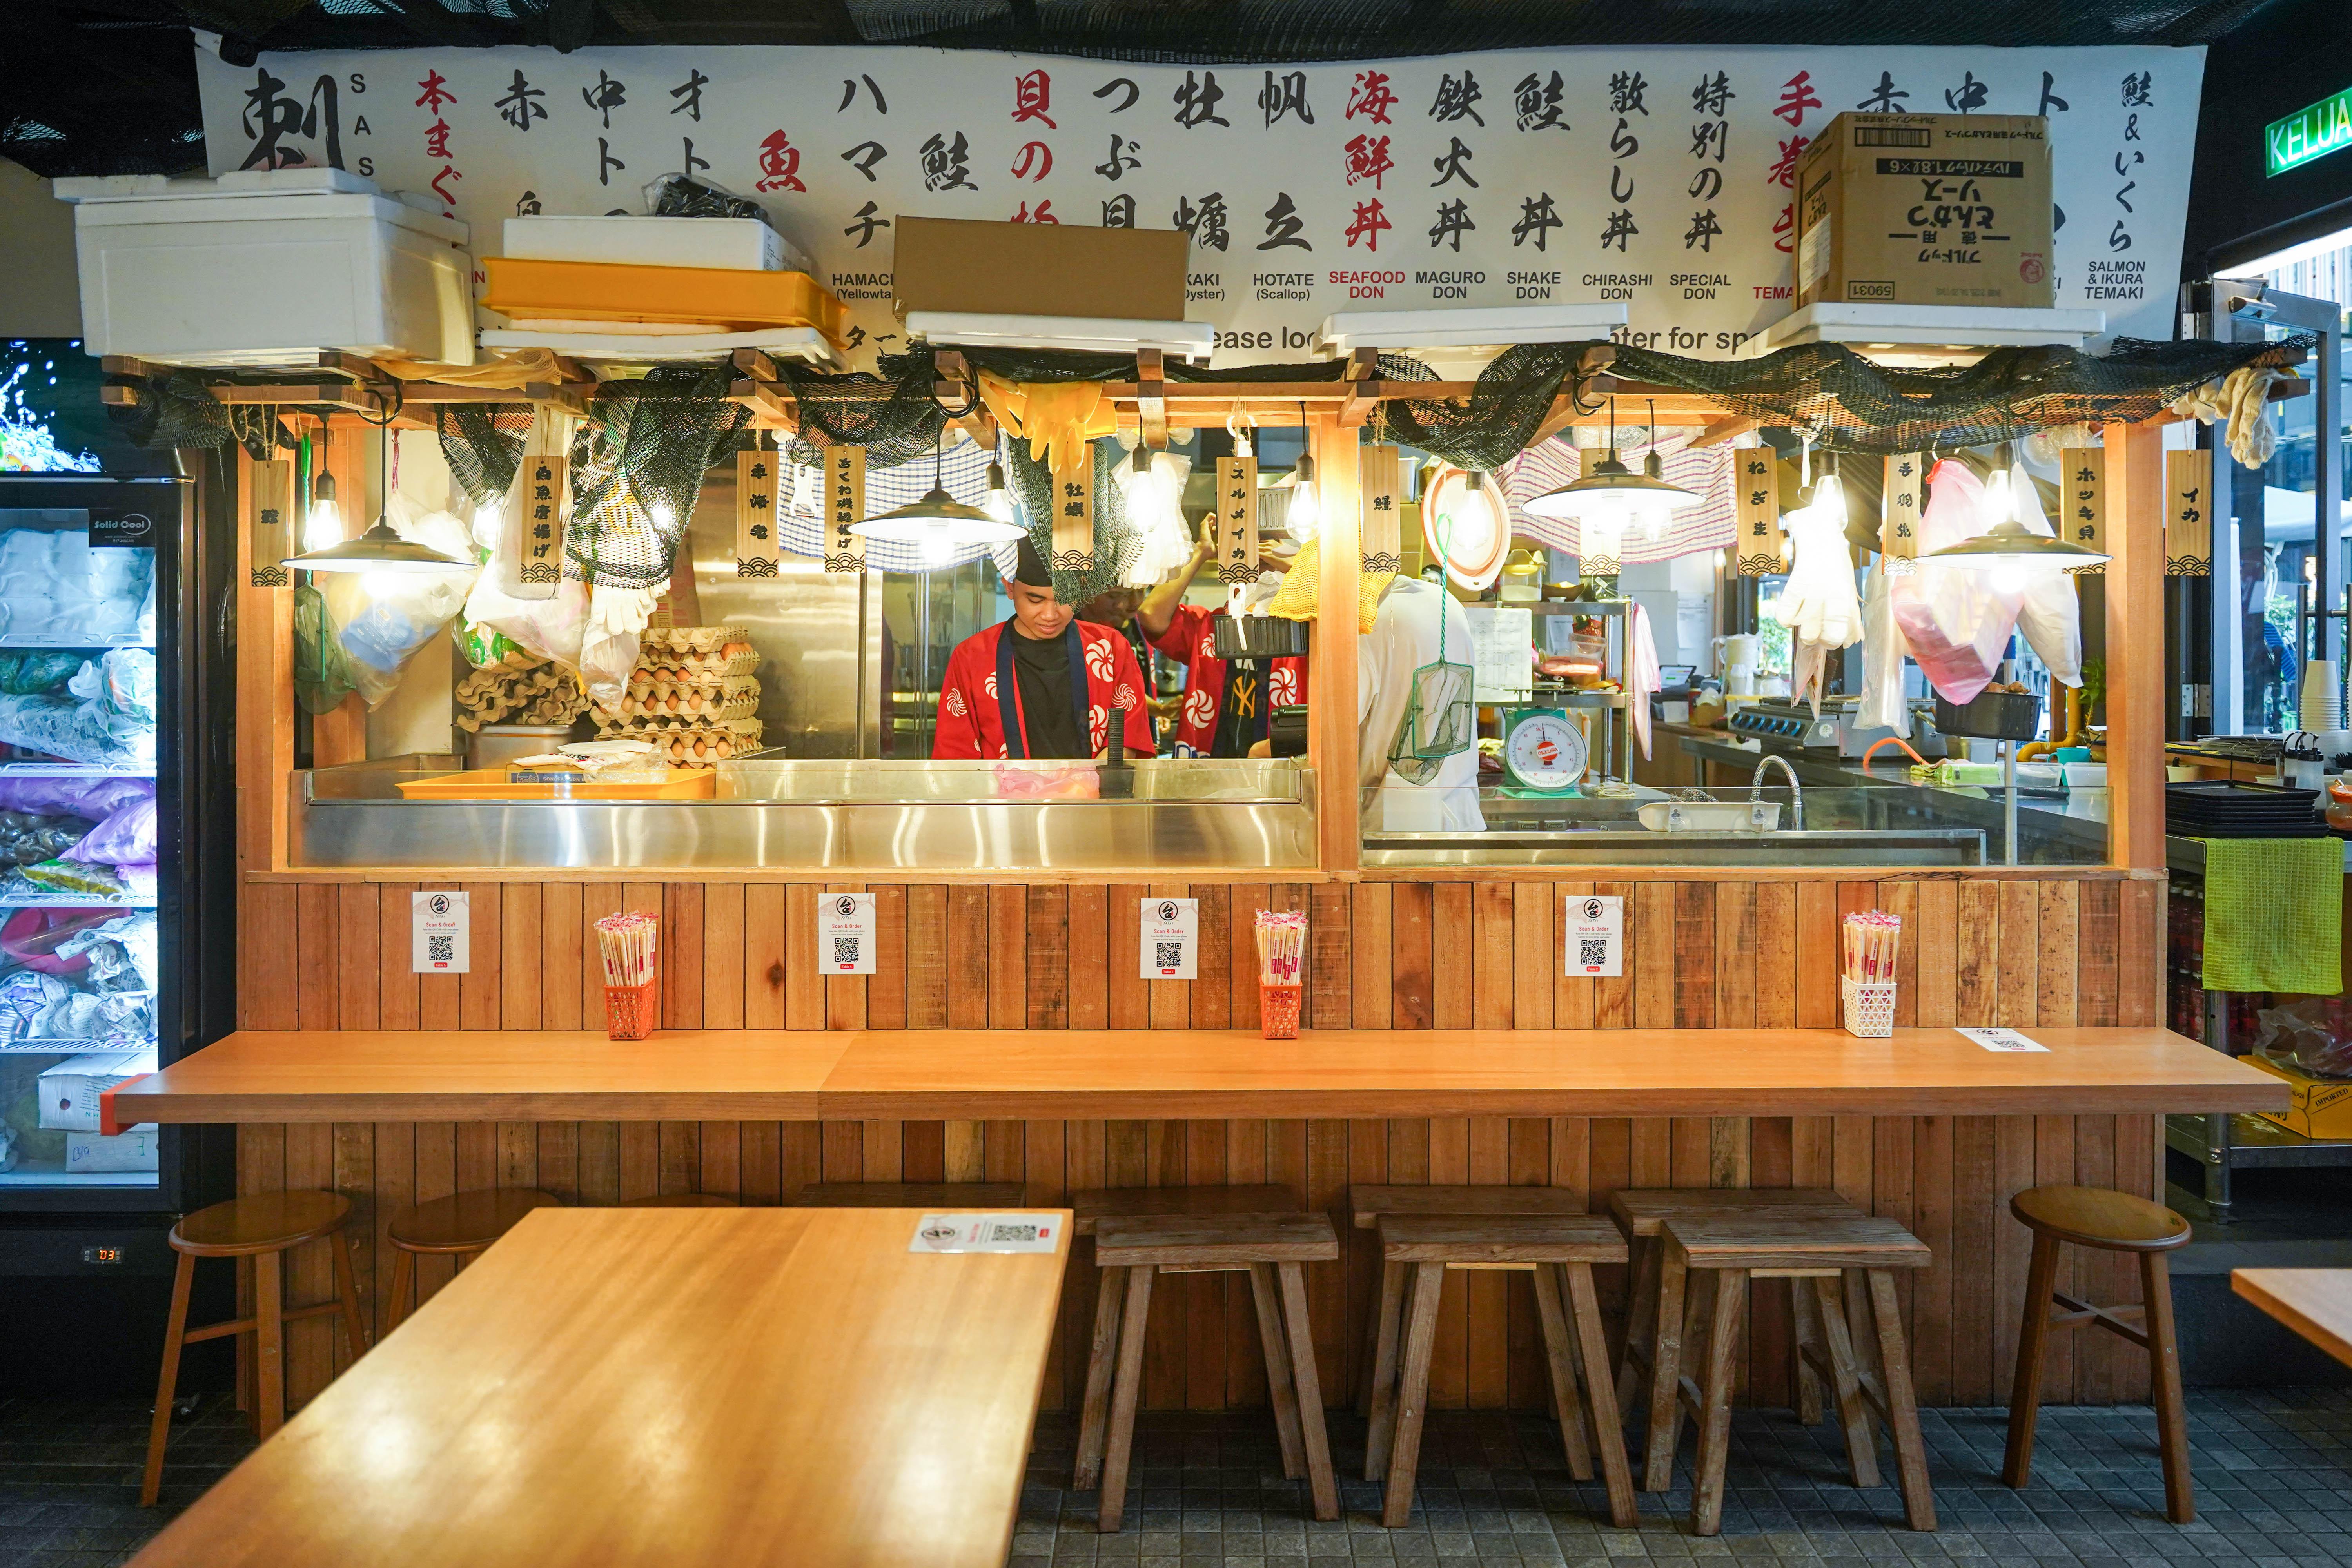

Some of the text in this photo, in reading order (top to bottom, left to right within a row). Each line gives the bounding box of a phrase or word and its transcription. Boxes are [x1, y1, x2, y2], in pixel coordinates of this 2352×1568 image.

[2270, 97, 2352, 169] KELUA
[415, 69, 463, 220] 本まぐ
[755, 129, 806, 193] 魚
[837, 74, 890, 249] ハマチ
[919, 131, 978, 192] 鮭
[1256, 70, 1315, 252] 帆立
[1344, 70, 1399, 252] 海鮮丼
[1429, 71, 1485, 252] 鉄火丼
[1512, 72, 1571, 252] 鮭丼
[1600, 70, 1649, 252] 散らし丼
[1684, 70, 1737, 252] 特別の丼
[1921, 178, 1981, 202] ソース
[2088, 260, 2145, 273] SALMON
[832, 273, 894, 286] HAMAC
[1253, 273, 1314, 286] HOTATE
[1329, 271, 1405, 284] SEAFOOD
[1415, 271, 1486, 284] MAGURO
[1507, 271, 1561, 285] SHAKE
[1582, 274, 1653, 286] CHIRASHI
[1670, 274, 1731, 286] SPECIAL
[2088, 273, 2143, 285] & IKURA
[837, 289, 891, 301] (Yellowta
[1256, 289, 1310, 301] (Scallop)
[1349, 286, 1384, 299] DON
[1432, 286, 1467, 299] DON
[1515, 287, 1550, 299] DON
[1601, 287, 1633, 300] DON
[1684, 287, 1716, 300] DON
[1853, 285, 1892, 296] 59031
[2084, 286, 2144, 300] TEMAKI
[1668, 326, 1708, 349] for
[1716, 332, 1760, 355] sp
[1748, 461, 1768, 536] ねぎま
[2076, 467, 2096, 541] ホッキ貝
[2181, 488, 2201, 523] イカ
[1230, 468, 1246, 560] スルメイカ
[120, 521, 145, 529] Cool
[1538, 747, 1558, 756] OKAZAWA
[2315, 1088, 2348, 1107] IMPORTED
